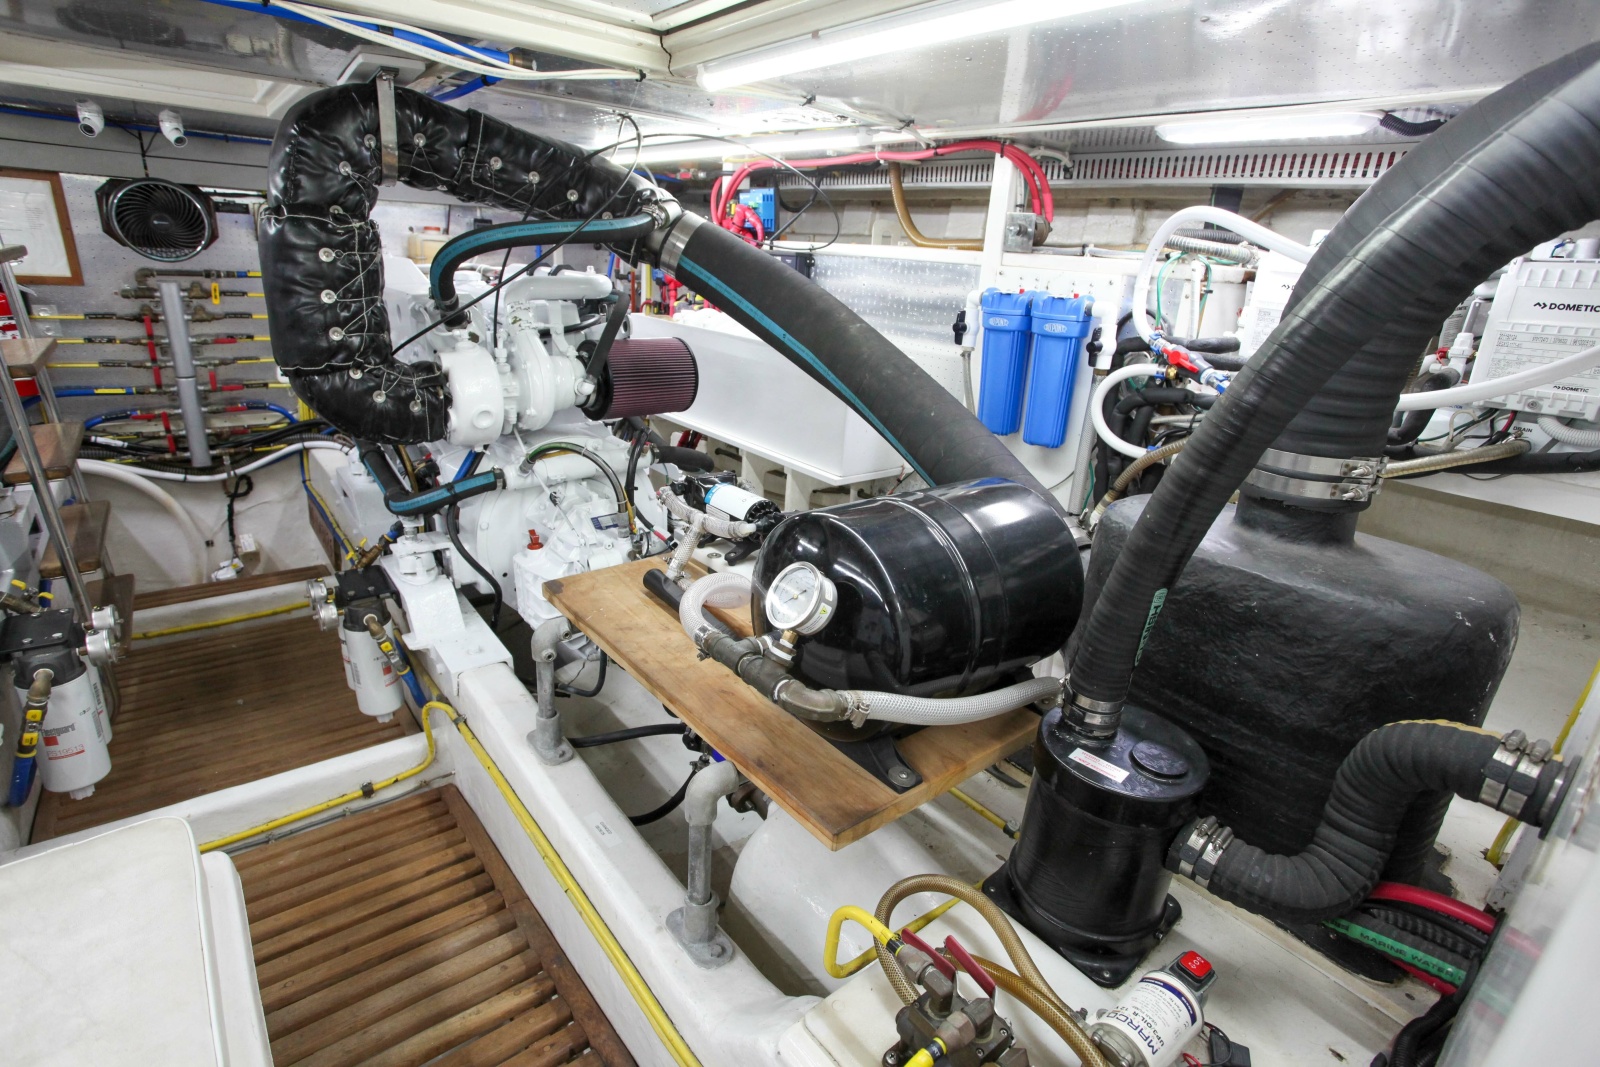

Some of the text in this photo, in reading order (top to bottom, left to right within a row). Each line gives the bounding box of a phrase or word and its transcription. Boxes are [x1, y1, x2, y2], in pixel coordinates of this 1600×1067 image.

[1549, 302, 1600, 313] DOMETIC
[1513, 425, 1533, 433] DRAIN
[1359, 932, 1454, 977] MARINE WATER
[1106, 1012, 1159, 1055] MARCO
